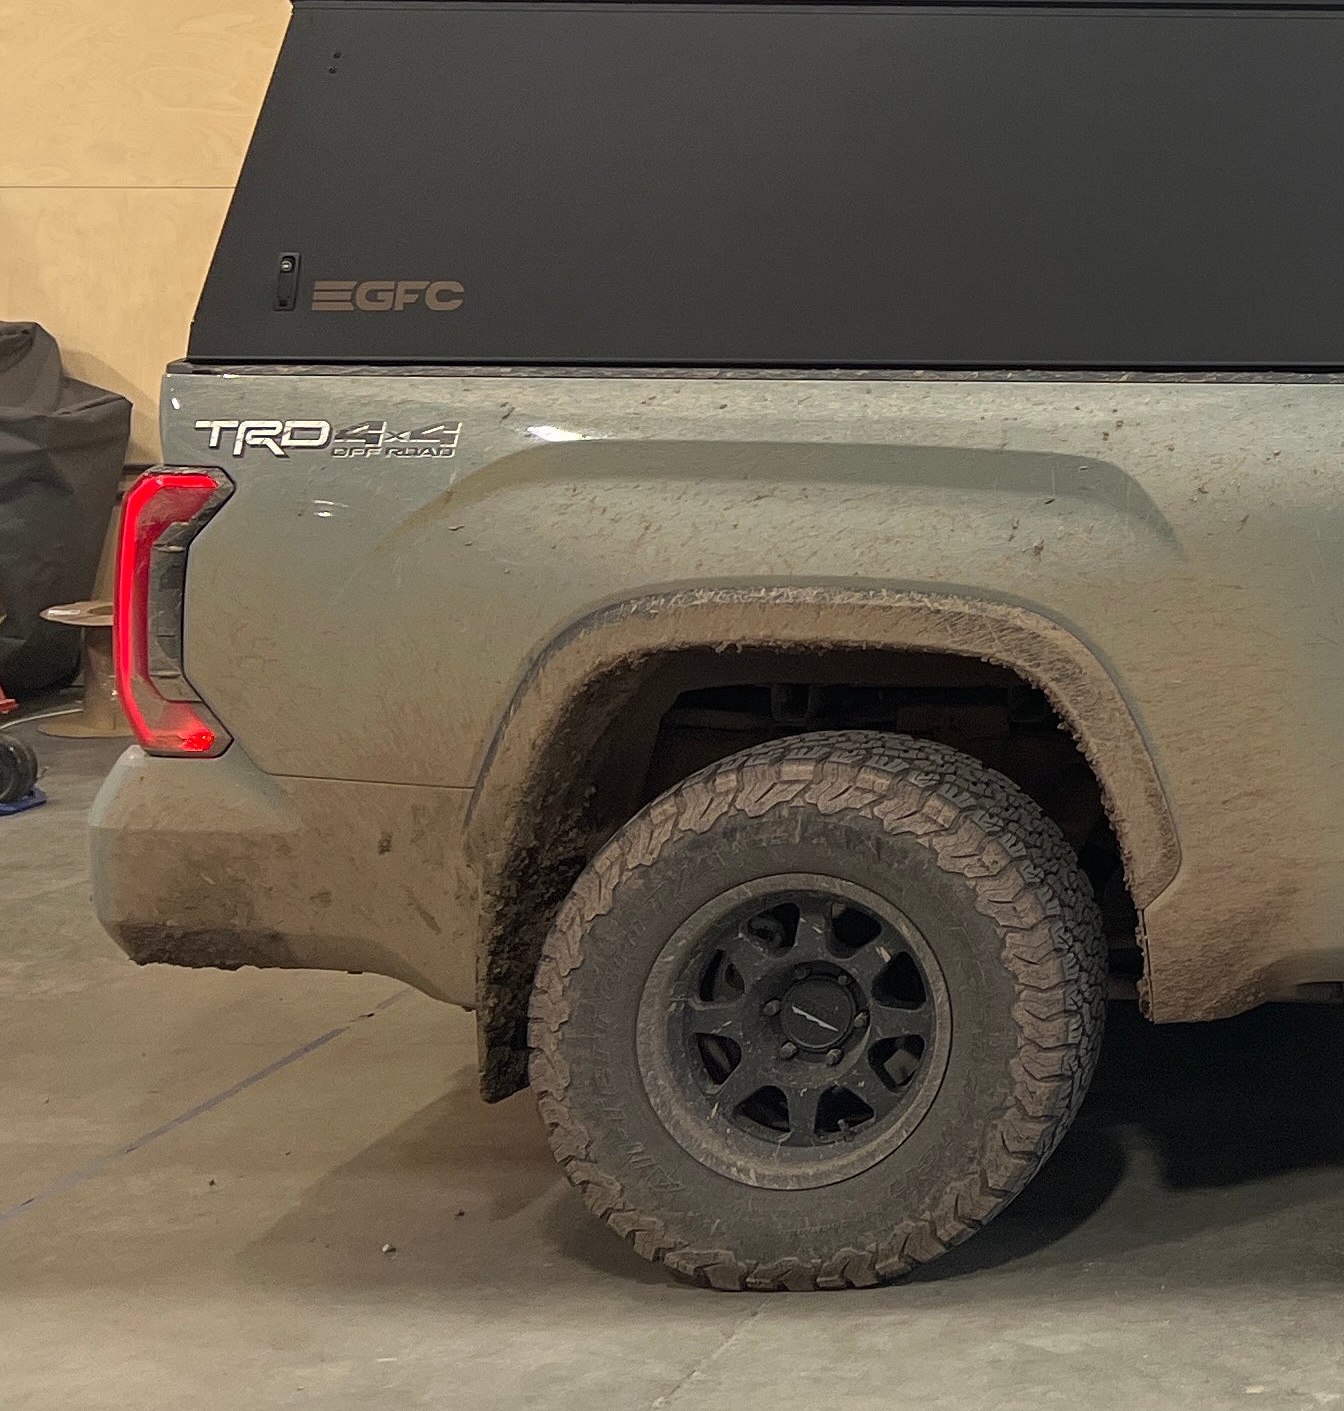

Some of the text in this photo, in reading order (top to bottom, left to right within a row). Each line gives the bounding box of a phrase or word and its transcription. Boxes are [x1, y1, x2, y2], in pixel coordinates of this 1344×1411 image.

[194, 420, 463, 458] TRD 4x4
[330, 446, 456, 459] OFF ROAD
